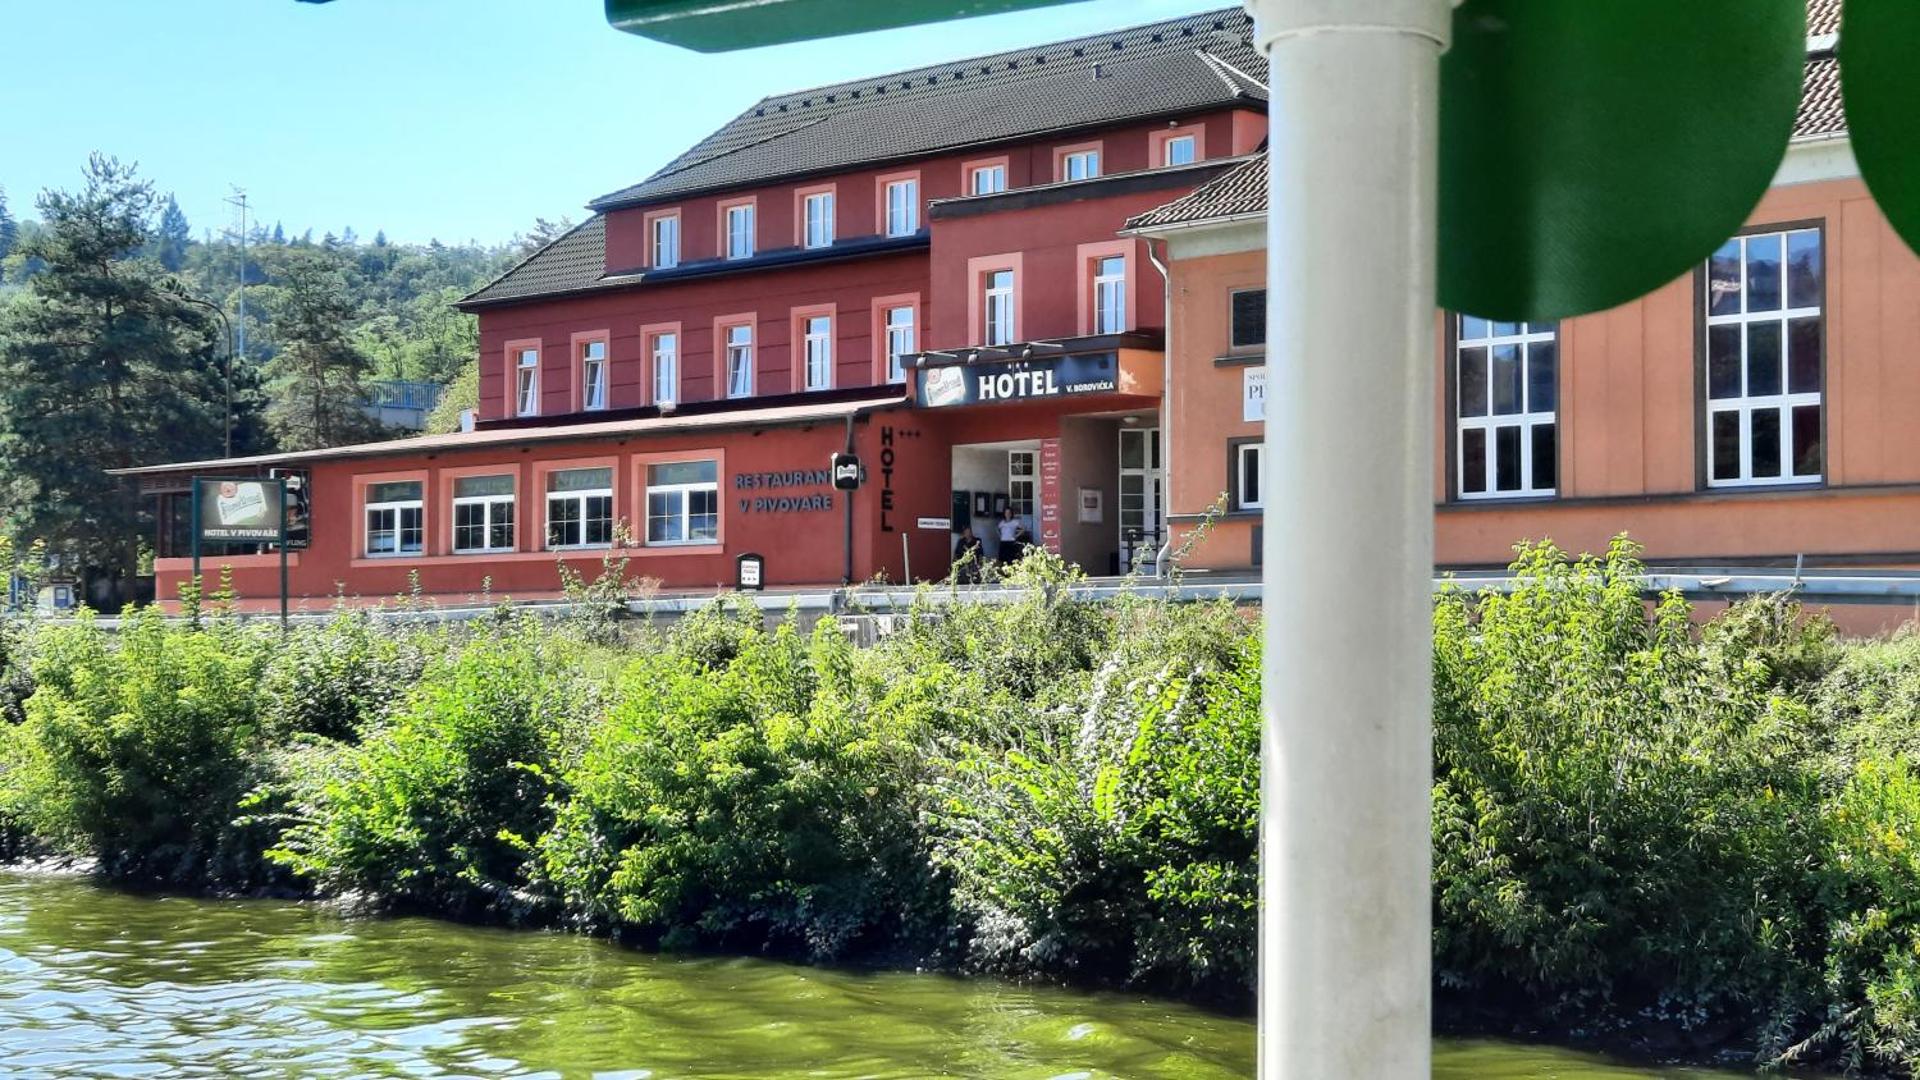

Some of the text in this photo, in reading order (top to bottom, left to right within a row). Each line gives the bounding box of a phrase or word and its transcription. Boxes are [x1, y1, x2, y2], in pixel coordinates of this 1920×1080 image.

[978, 370, 1059, 400] HOTEL
[1073, 379, 1115, 393] BOROVIČKA
[734, 470, 832, 490] RESTAURAN
[881, 426, 895, 532] HOTEL
[739, 493, 833, 513] V PIVOVAŘE
[204, 529, 230, 537] HOTEL
[238, 527, 278, 537] PIVOVAŘE
